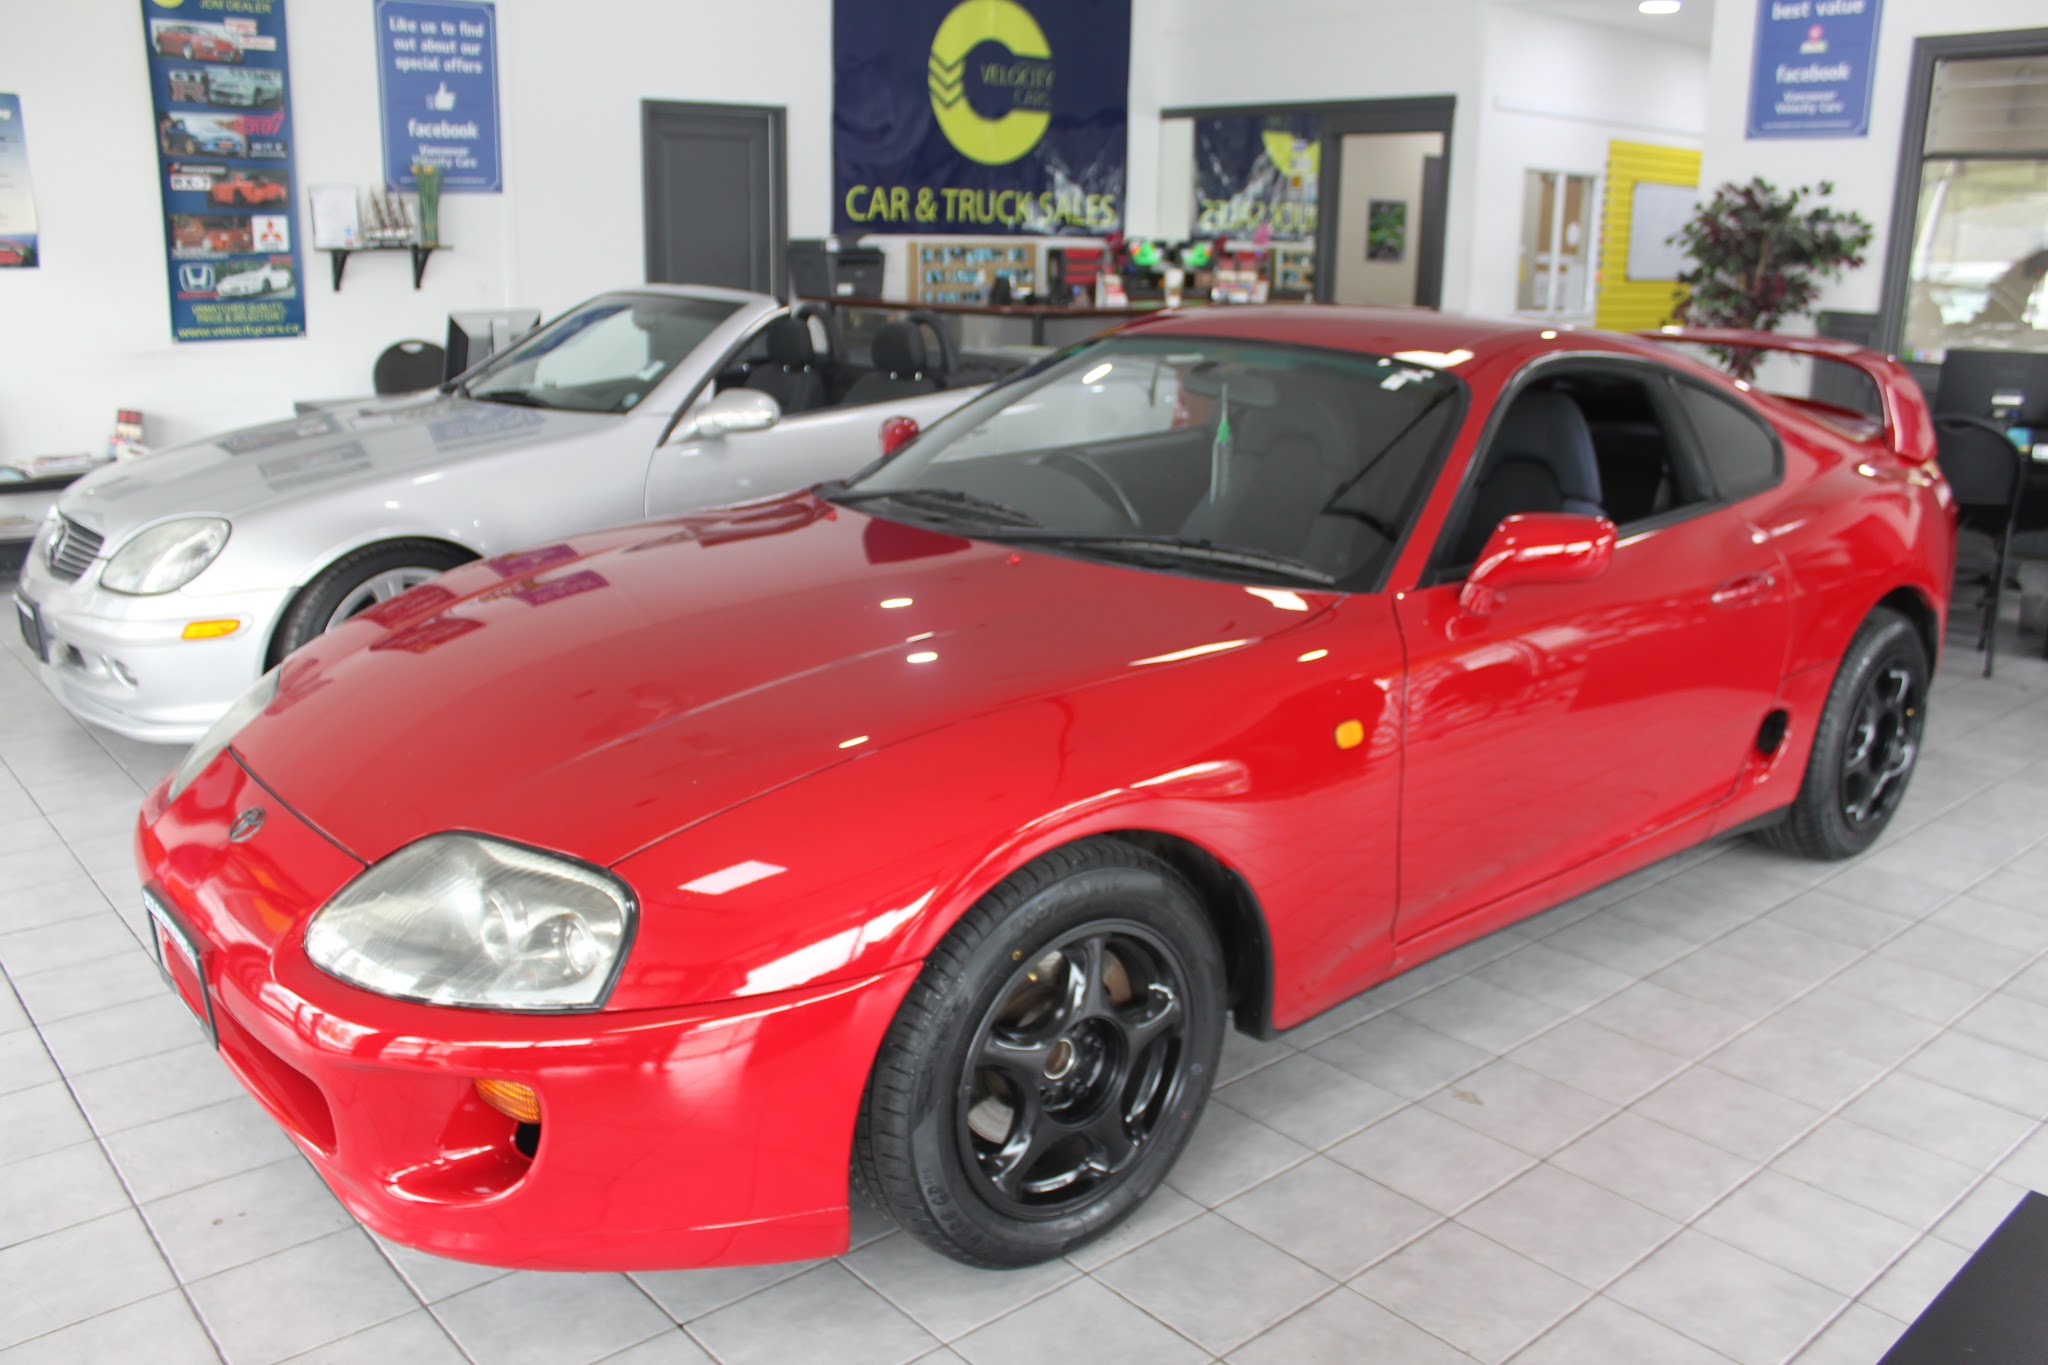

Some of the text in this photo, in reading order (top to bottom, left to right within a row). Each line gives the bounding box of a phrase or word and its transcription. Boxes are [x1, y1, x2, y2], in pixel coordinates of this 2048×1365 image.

[226, 0, 272, 14] DEALER
[1771, 0, 1865, 20] best value
[389, 15, 485, 38] Like us to find
[393, 37, 482, 56] out about our
[395, 56, 483, 74] special offers
[1775, 62, 1851, 84] facebook
[408, 117, 479, 140] facebook
[845, 184, 1117, 228] CAR & TRUCK SALES
